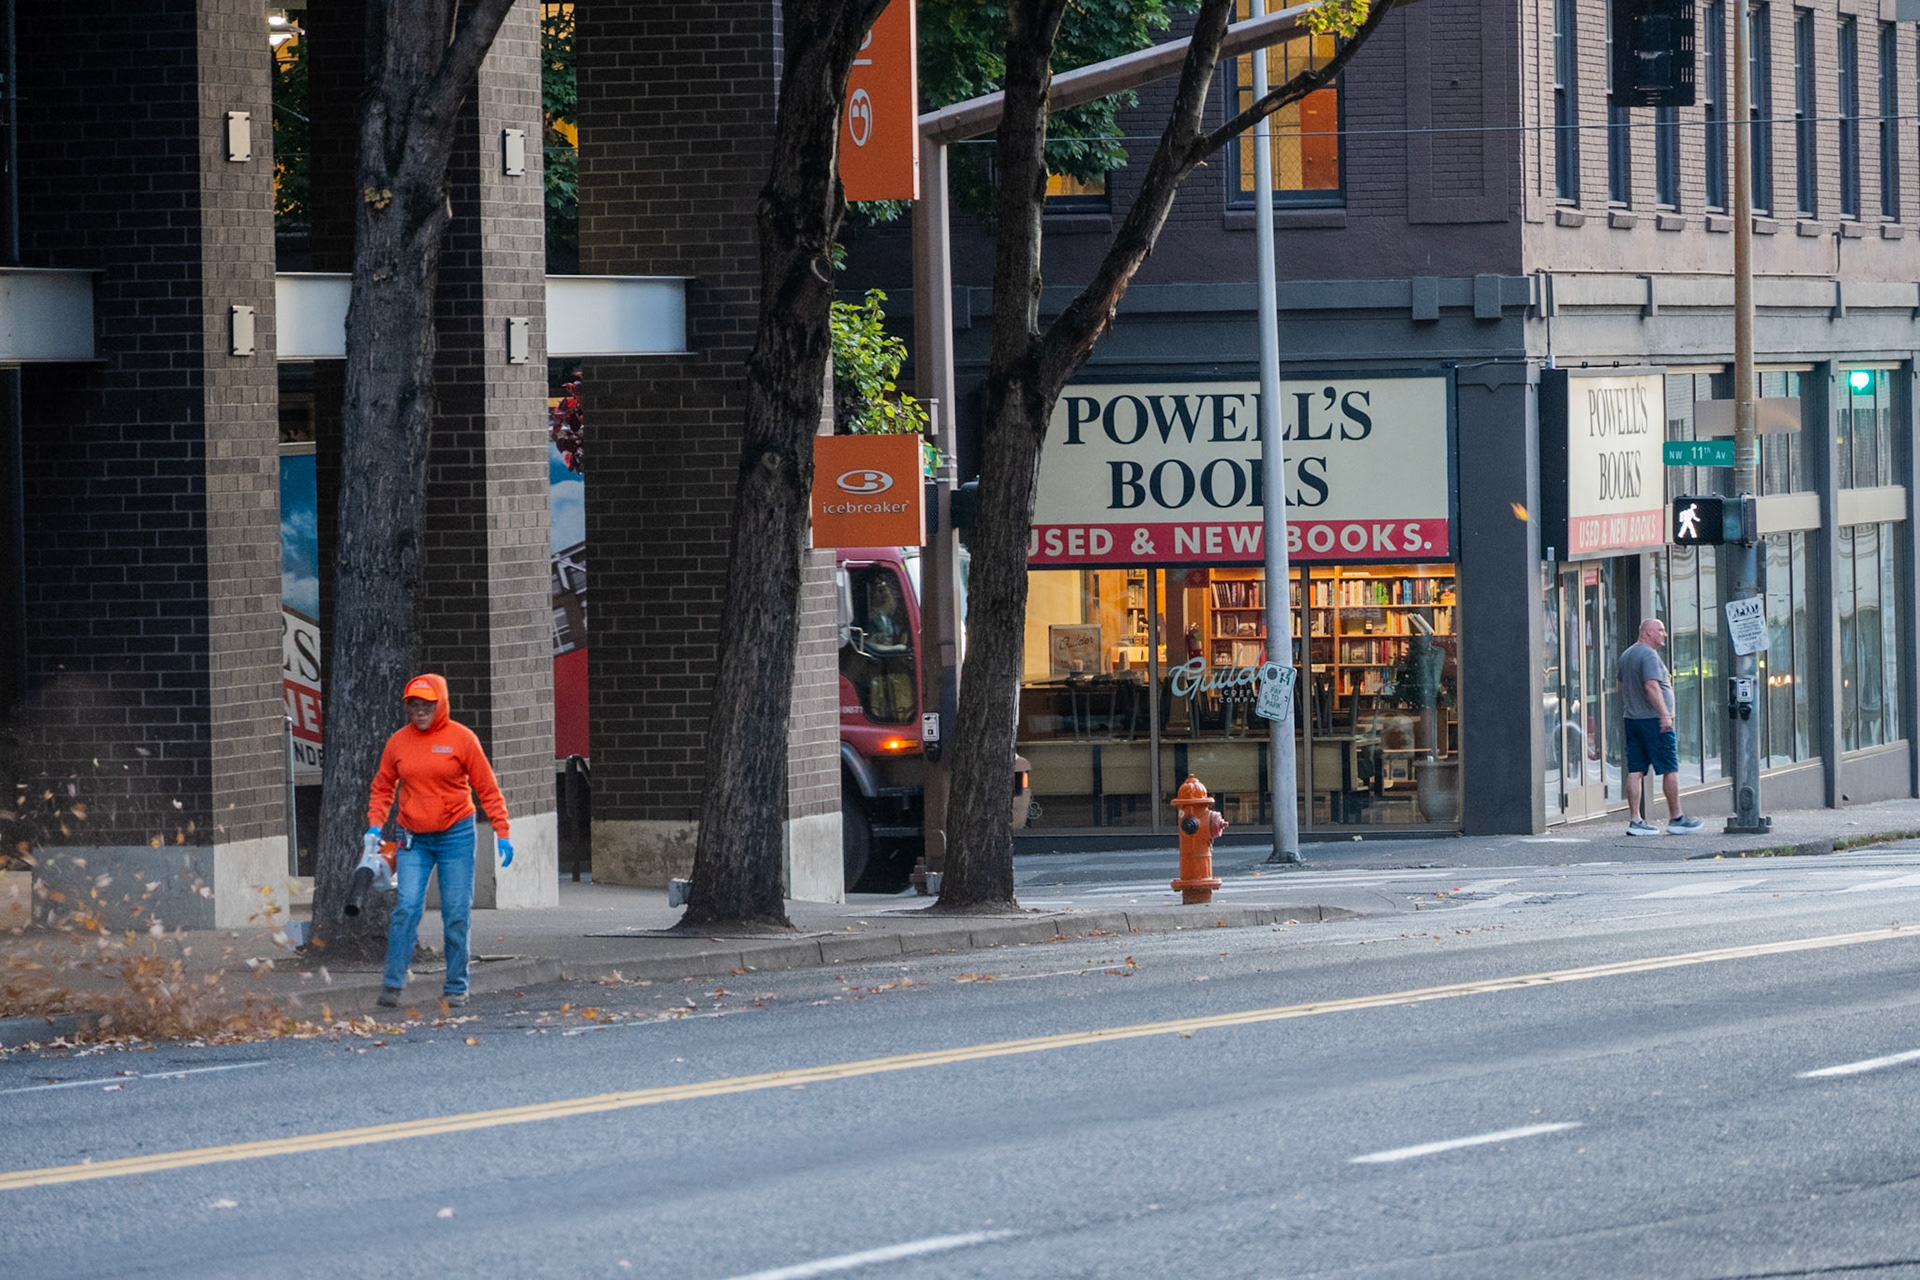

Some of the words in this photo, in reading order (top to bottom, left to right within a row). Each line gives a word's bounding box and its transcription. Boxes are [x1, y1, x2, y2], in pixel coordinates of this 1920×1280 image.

[1062, 386, 1372, 445] POWELL'S
[1588, 382, 1648, 437] POWELL'S
[1669, 450, 1683, 460] NW
[1691, 446, 1711, 460] 11th
[1715, 450, 1726, 460] Av
[1106, 456, 1330, 510] BOOKS
[1598, 450, 1642, 501] BOOKS
[822, 500, 908, 514] icebreaker
[1130, 527, 1157, 556] &
[1174, 525, 1263, 554] NEW
[1286, 523, 1432, 553] BOOKS.
[1579, 520, 1600, 549] USED
[1601, 520, 1608, 546] &
[1609, 517, 1629, 546] NEW
[1629, 513, 1656, 543] BOOKS
[1168, 656, 1264, 700] Guild
[1223, 689, 1259, 697] COFF
[1270, 686, 1282, 695] PAY
[283, 688, 322, 733] NE
[1265, 699, 1282, 710] PARK
[1271, 693, 1280, 702] TO
